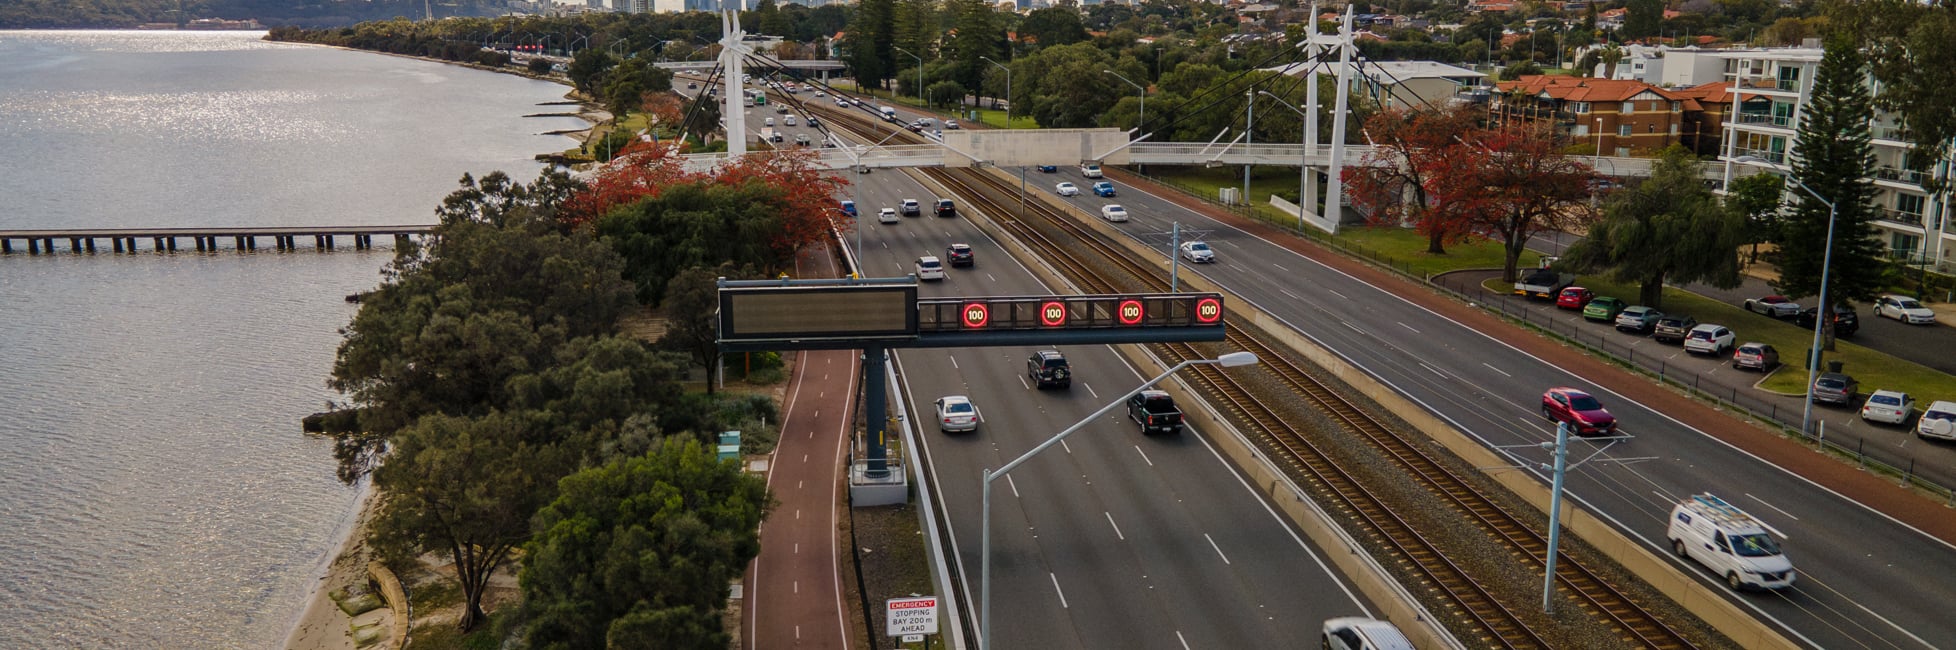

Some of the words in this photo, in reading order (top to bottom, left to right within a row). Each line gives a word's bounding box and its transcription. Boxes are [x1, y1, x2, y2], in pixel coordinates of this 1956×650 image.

[968, 310, 984, 320] 100
[1046, 308, 1062, 319] 100
[1123, 307, 1139, 317] 100
[1201, 305, 1217, 315] 100
[891, 601, 934, 609] EMERGENCY
[895, 609, 930, 617] STOPPING
